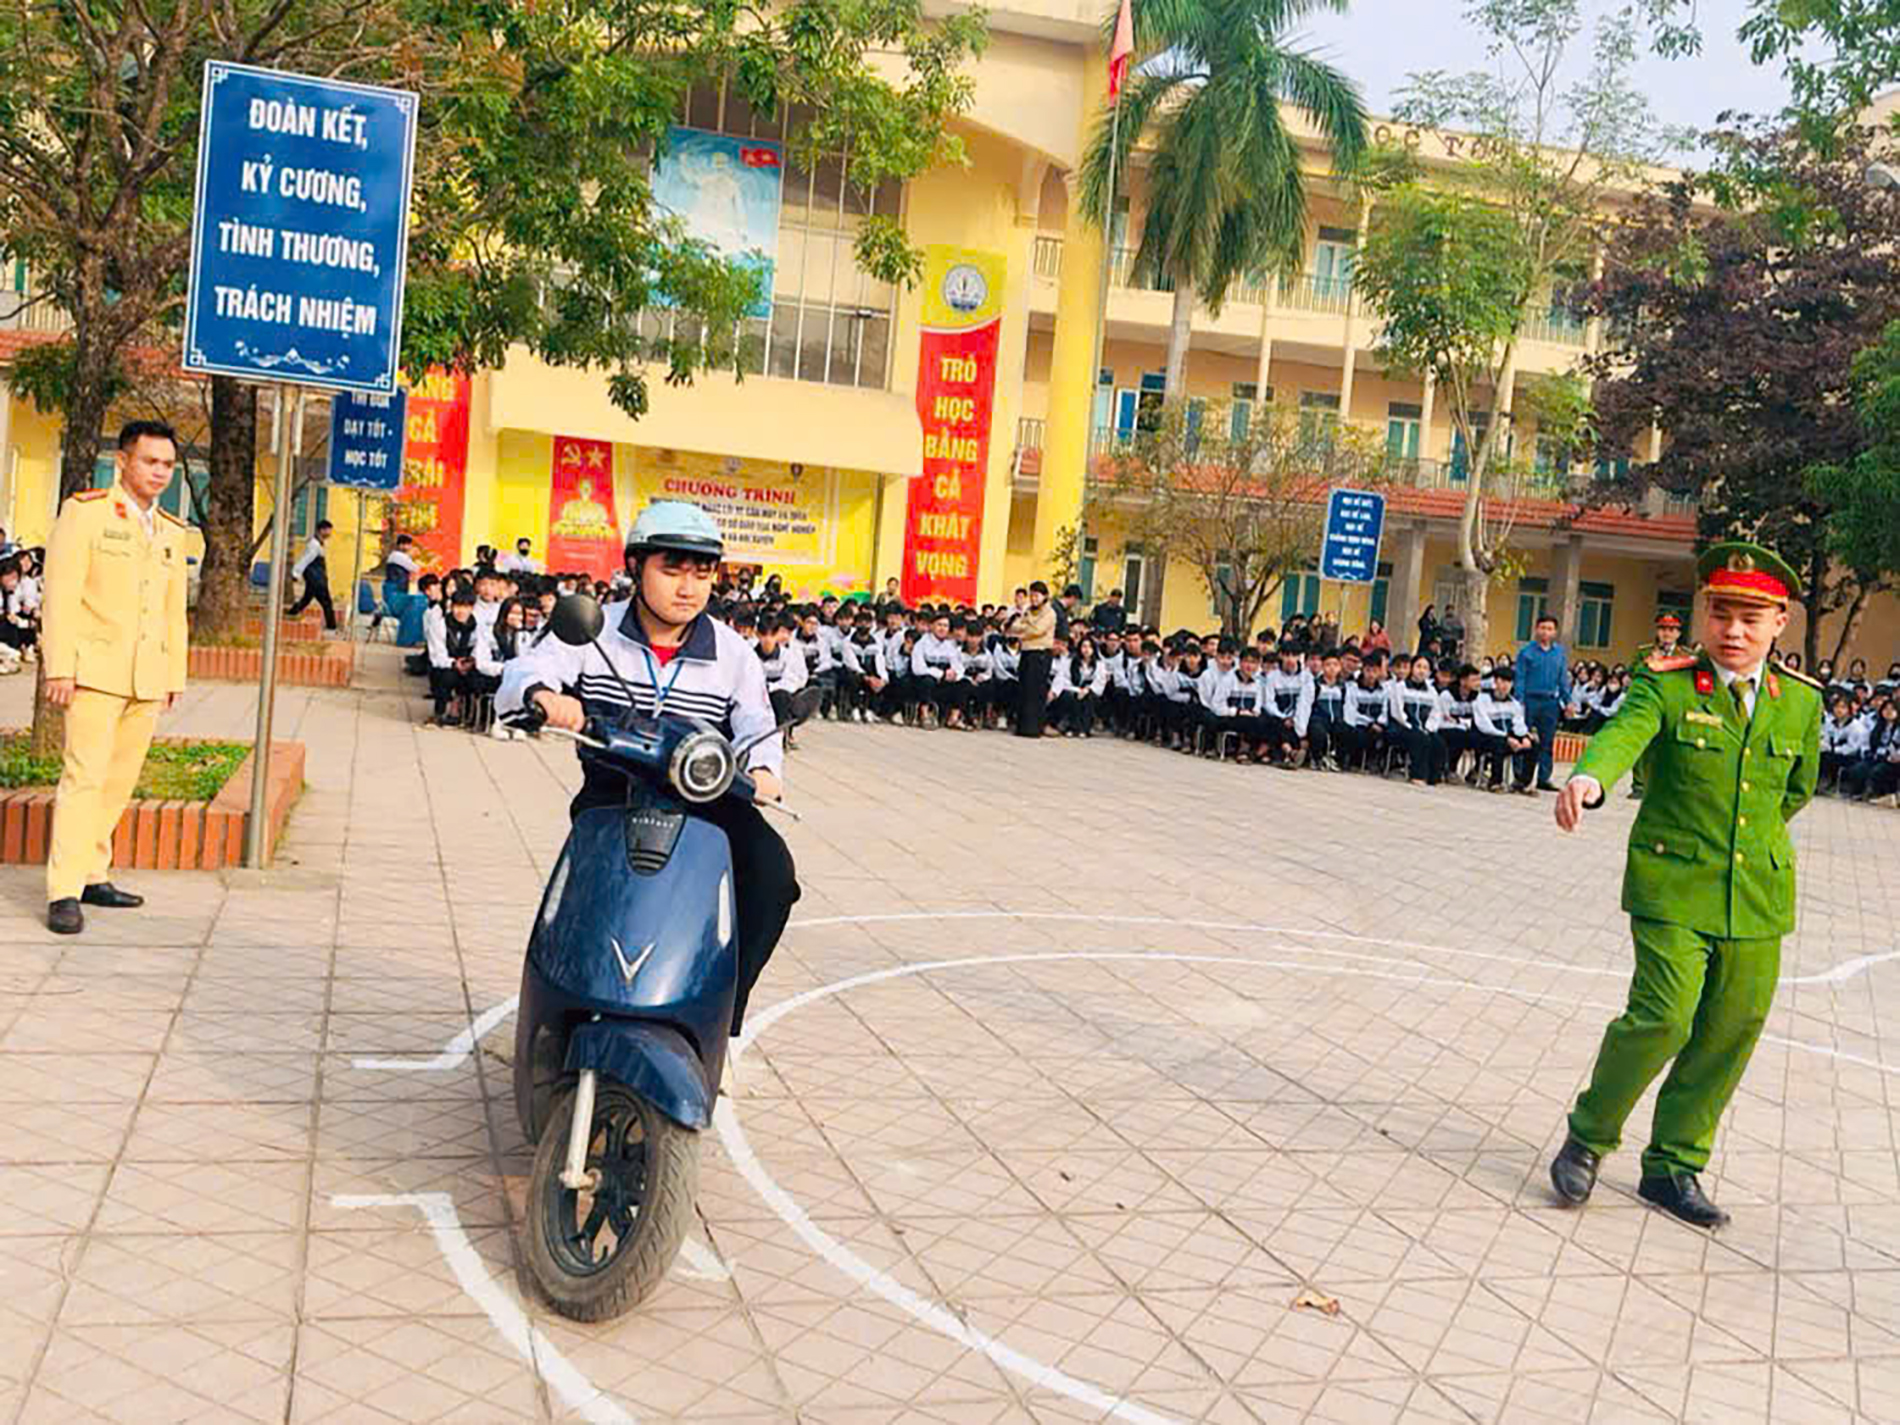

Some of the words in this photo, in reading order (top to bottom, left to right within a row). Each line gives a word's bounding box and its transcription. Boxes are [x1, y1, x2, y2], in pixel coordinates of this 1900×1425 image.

[249, 97, 316, 138] ĐOÀN
[322, 103, 368, 150] KẾT,
[241, 153, 274, 194] KỶ
[279, 166, 367, 213] CƯƠNG,
[218, 217, 274, 258] TÌNH
[281, 230, 380, 278] THƯƠNG,
[214, 284, 292, 324] TRÁCH
[298, 297, 377, 339] NHIỆM
[934, 396, 975, 426] HỌC
[343, 418, 365, 439] DẠY
[366, 417, 387, 439] TỐT
[343, 448, 367, 469] HỌC
[368, 447, 388, 469] TỐT
[919, 509, 971, 541] KHÁT
[914, 550, 969, 580] VỌNG
